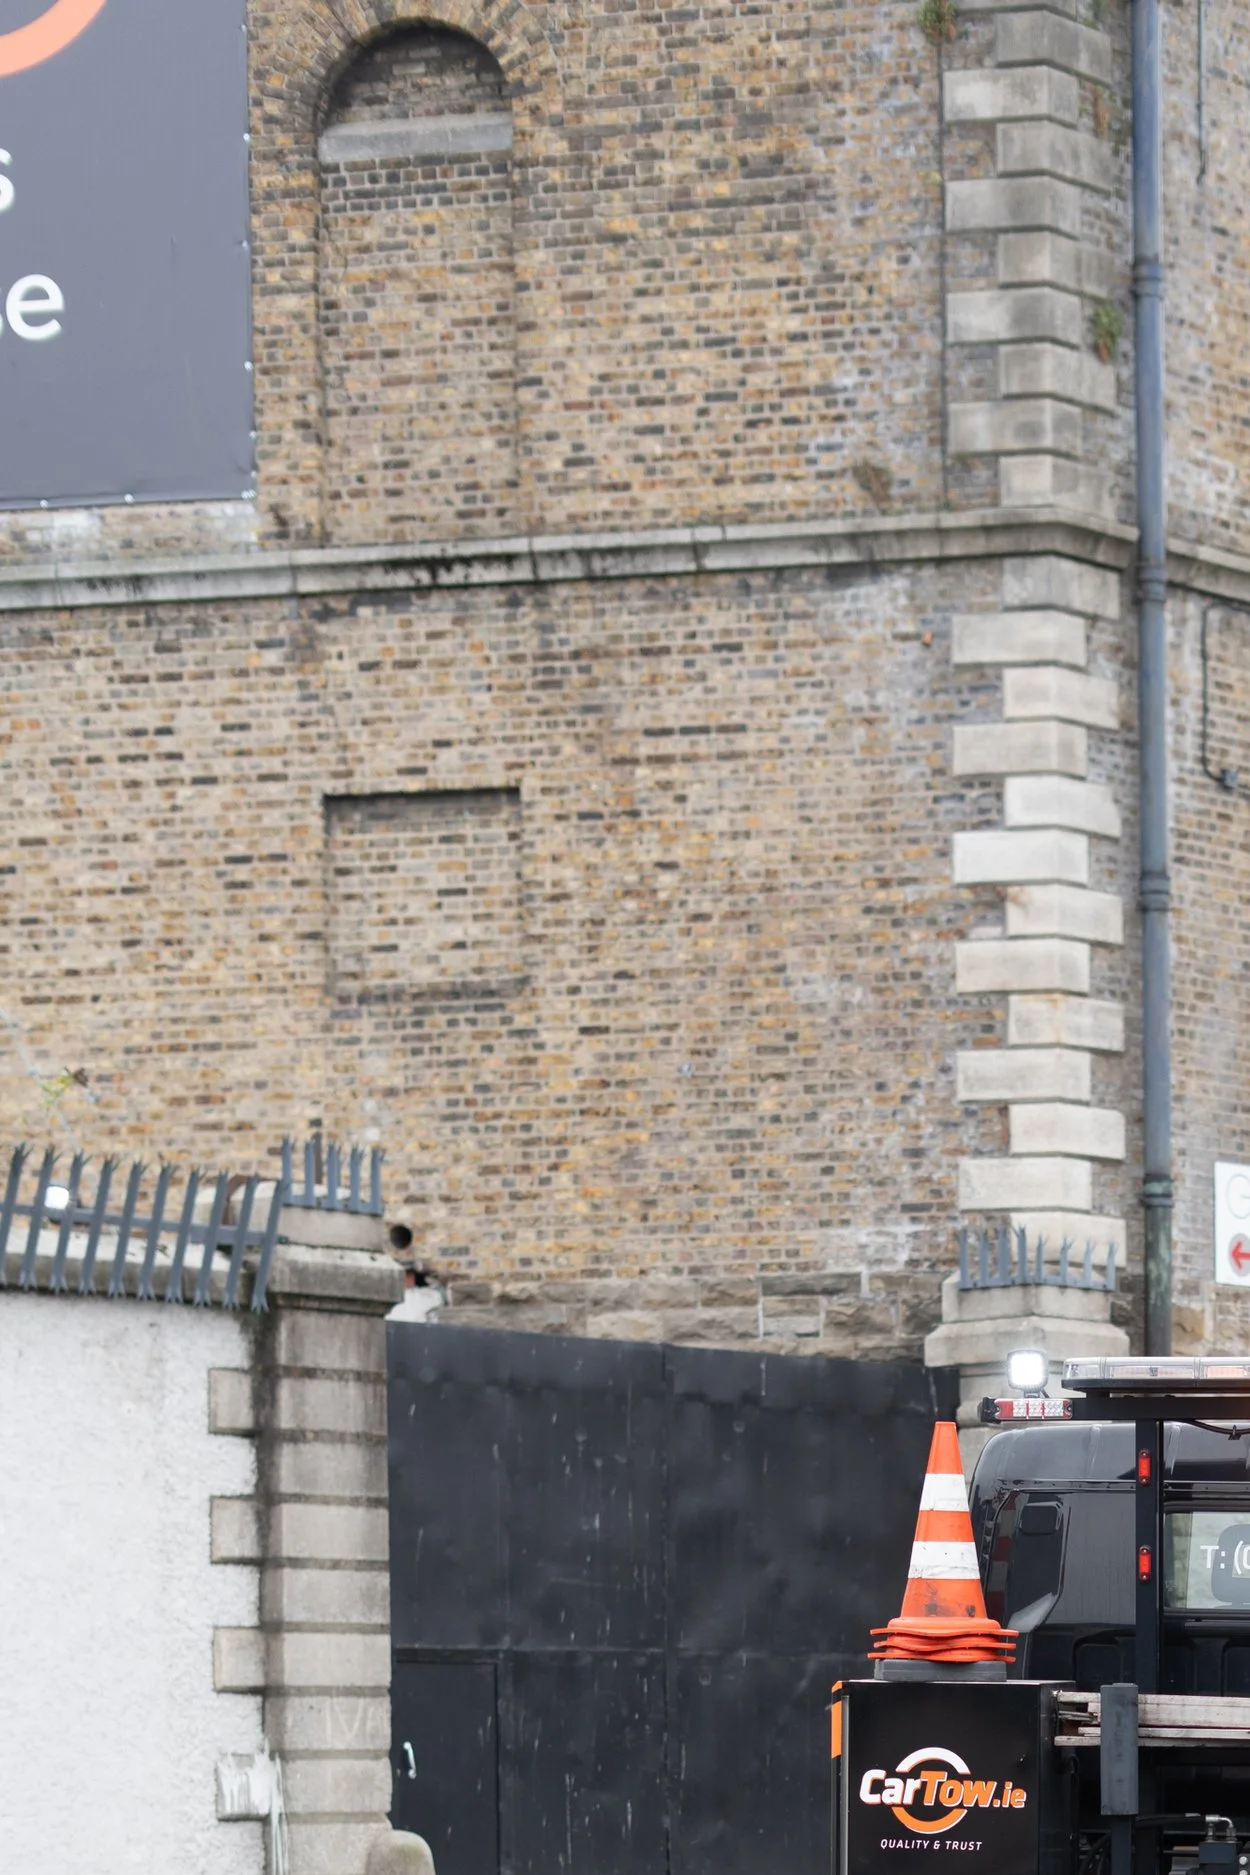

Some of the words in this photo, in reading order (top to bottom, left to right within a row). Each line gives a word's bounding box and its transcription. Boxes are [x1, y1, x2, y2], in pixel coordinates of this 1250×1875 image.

[1200, 1545, 1226, 1569] T:
[880, 1838, 930, 1850] QUALITY
[933, 1840, 941, 1850] &
[945, 1840, 983, 1851] TRUST
